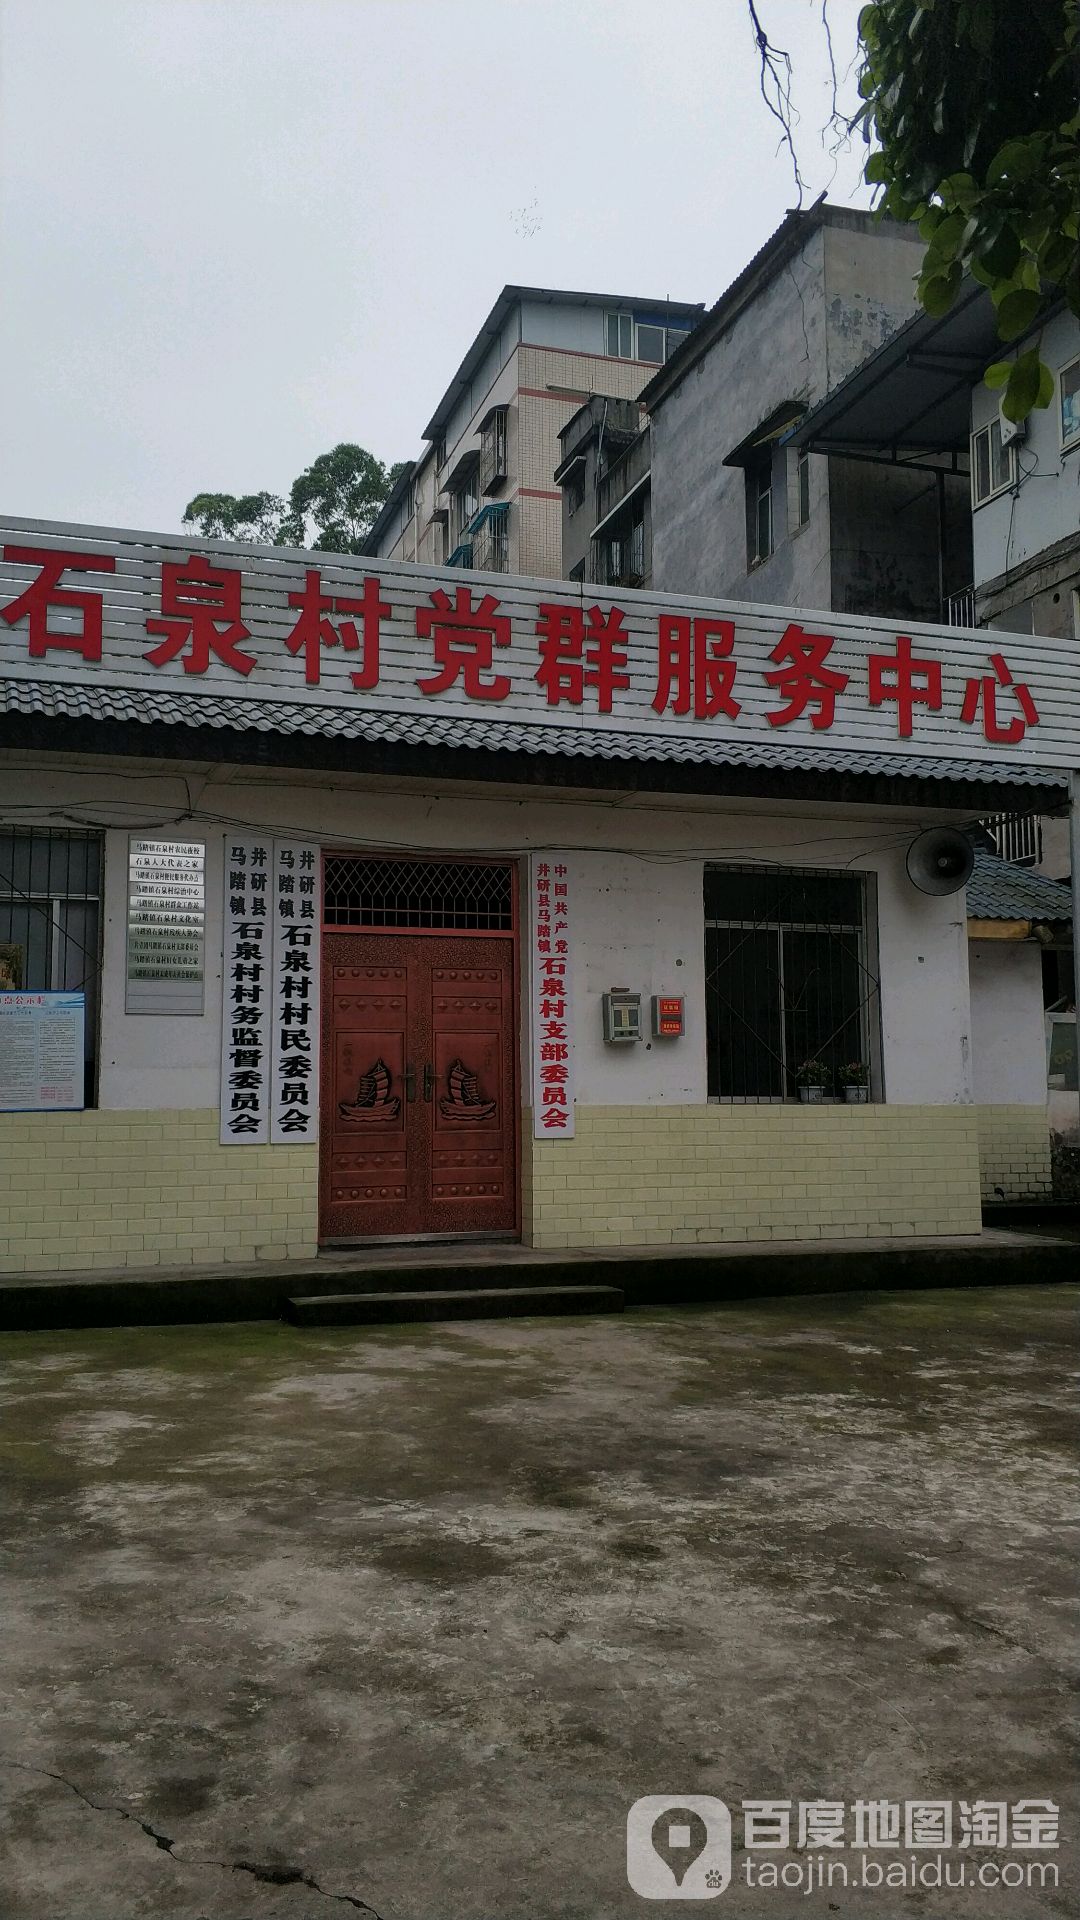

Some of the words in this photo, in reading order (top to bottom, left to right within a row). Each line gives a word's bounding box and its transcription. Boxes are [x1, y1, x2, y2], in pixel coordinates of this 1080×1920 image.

[0, 545, 1039, 745] 石泉村党群服务中心
[135, 857, 199, 869] 石泉人大代表之家
[229, 845, 247, 917] 马踏镇
[250, 847, 268, 917] 井研县
[278, 849, 296, 919] 马踏镇
[299, 850, 316, 920] 井研县
[536, 863, 551, 954] 井研县马踏镇
[554, 863, 569, 955] 中国共产党
[228, 921, 265, 1134] 石泉村村务监督委员会
[277, 924, 314, 1134] 石泉村村民委员会
[539, 956, 570, 1129] 石泉村支部委员会
